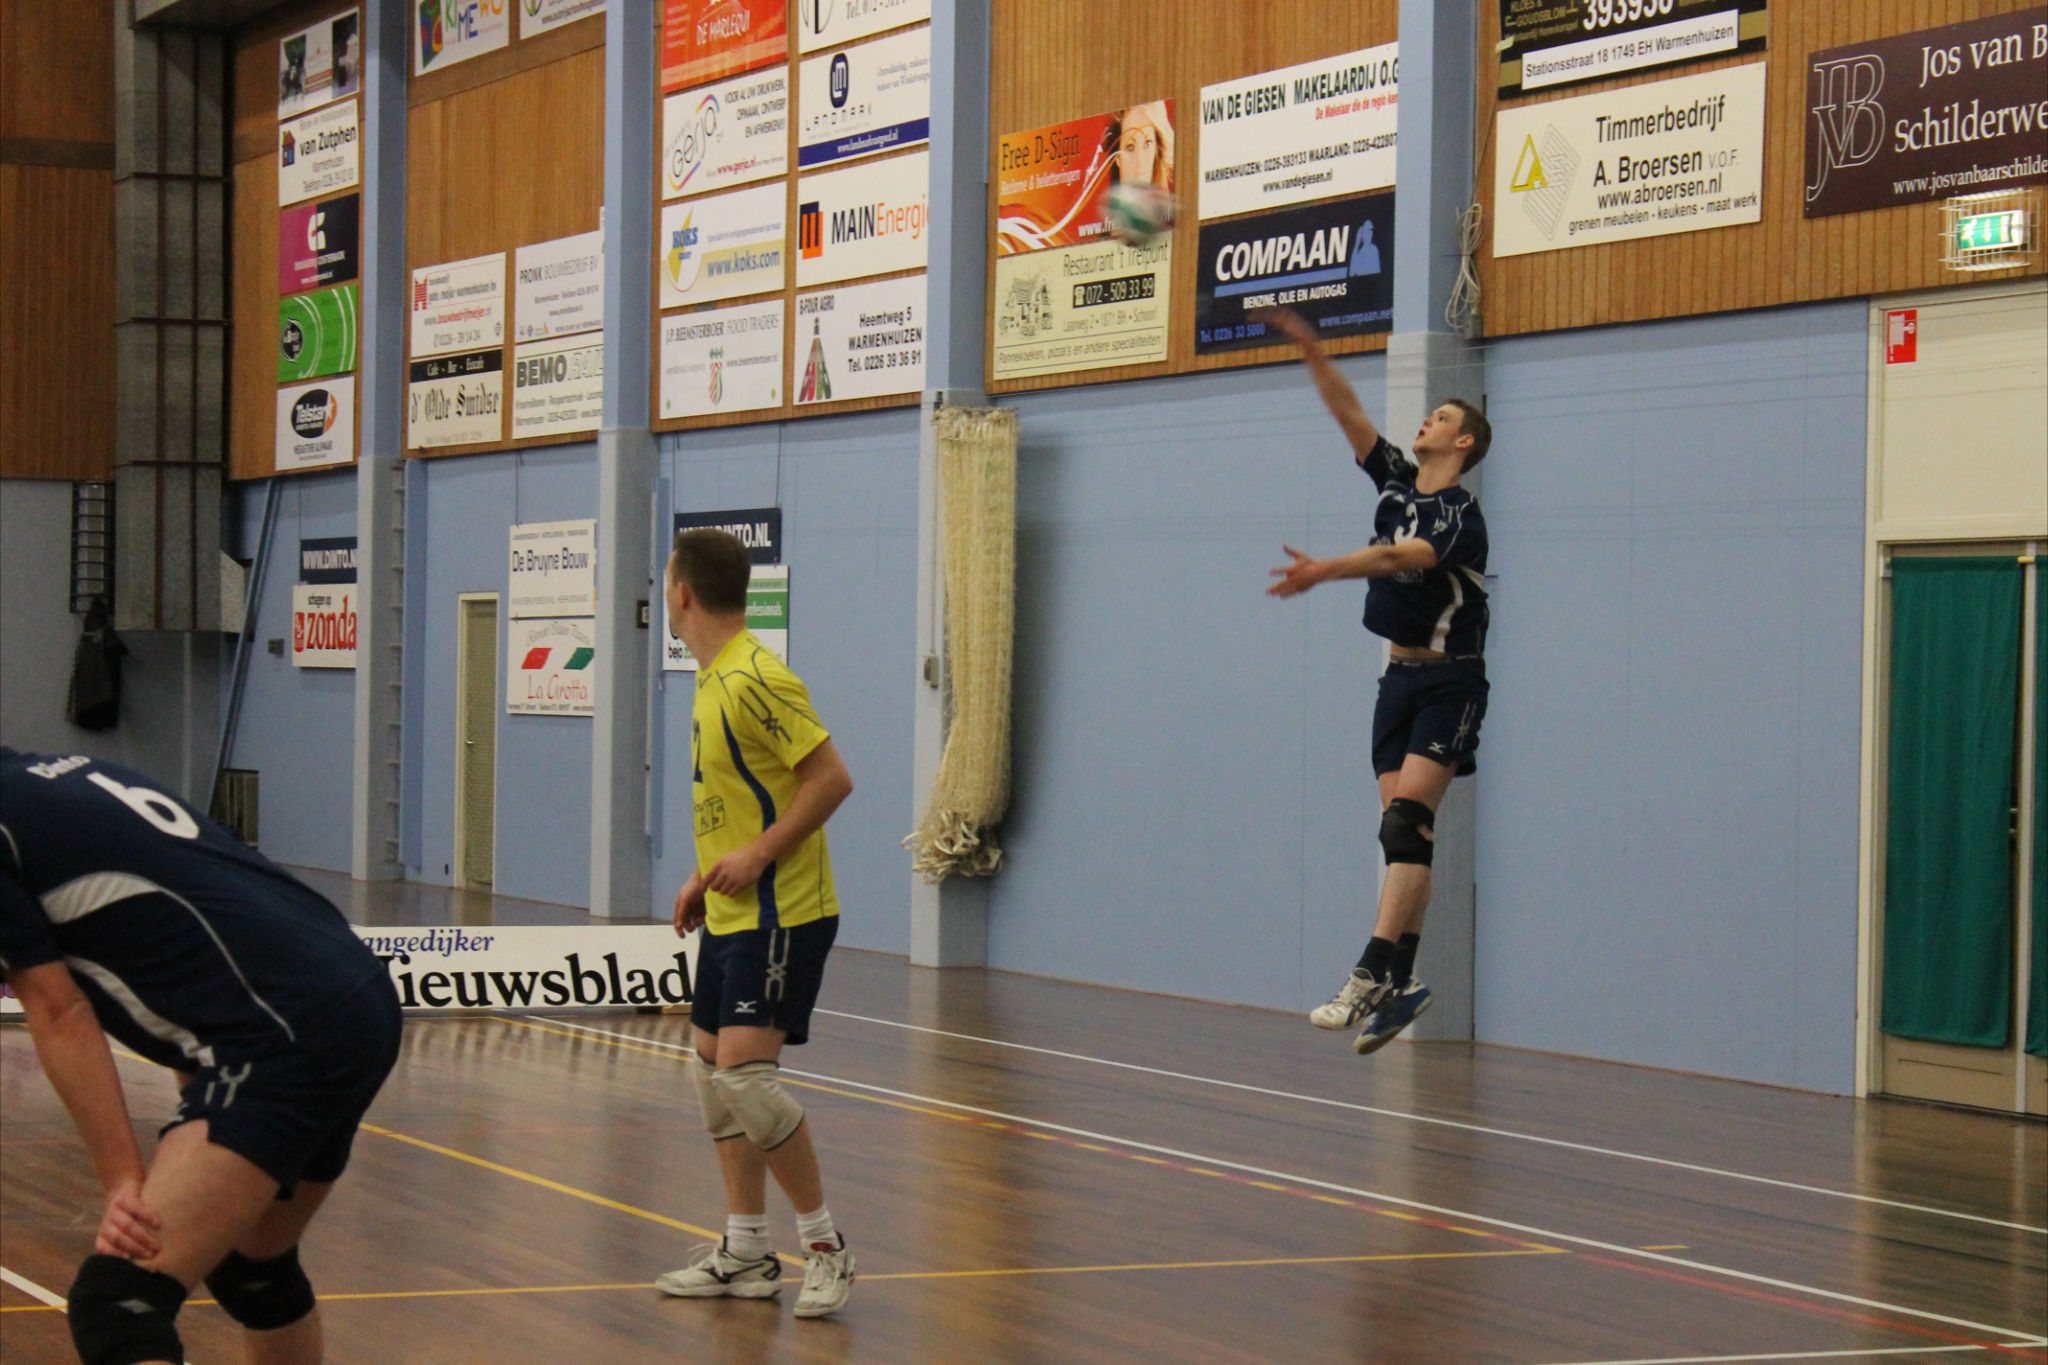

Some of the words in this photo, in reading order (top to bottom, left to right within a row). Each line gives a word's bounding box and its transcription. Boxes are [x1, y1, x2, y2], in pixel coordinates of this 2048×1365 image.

[1525, 55, 1595, 78] Stationsstraat
[1597, 49, 1609, 64] 18
[1611, 43, 1636, 60] 1749
[1637, 41, 1653, 56] EH
[1656, 24, 1735, 52] Warmenhuizen
[1918, 45, 1962, 89] Jos
[1968, 32, 2024, 70] van
[1203, 97, 1225, 125] VAN
[1227, 92, 1242, 120] DE
[1244, 83, 1287, 117] GIESEN
[1293, 62, 1378, 105] MAKELAARDIJ
[1595, 94, 1727, 144] Timmerbedrijf
[318, 125, 357, 152] Zutphen
[1002, 142, 1030, 171] Free
[1034, 130, 1081, 167] D-Sign
[1593, 160, 1612, 188] A.
[1618, 150, 1703, 184] Broersen
[1707, 148, 1740, 170] V.O.F.
[1597, 172, 1723, 209] www.abroersen.nl
[1568, 217, 1601, 236] grenen
[1602, 208, 1649, 229] meubelen
[1657, 199, 1698, 221] keukens
[1706, 196, 1731, 214] maat
[1733, 190, 1759, 209] werk
[672, 227, 698, 249] KOKS
[1214, 224, 1350, 282] COMPAAN
[706, 249, 780, 278] www.koks.com
[1063, 252, 1115, 277] Restaurant
[1242, 293, 1278, 310] BENZINE,
[1278, 290, 1296, 305] OLIE
[1297, 288, 1308, 301] EN
[1309, 282, 1348, 300] AUTOGAS
[859, 308, 905, 328] Heemtweg
[906, 304, 912, 322] 5
[847, 326, 923, 352] WARMENHUIZEN
[516, 353, 568, 388] BEMO
[847, 356, 862, 374] Tel.
[864, 353, 885, 372] 0226
[887, 351, 898, 369] 39
[899, 350, 910, 368] 36
[512, 550, 524, 572] De
[527, 548, 560, 577] Bruyne
[562, 546, 589, 570] Bouw
[306, 594, 357, 650] zonda
[86, 771, 200, 840] 6
[362, 929, 495, 957] angedijker
[376, 951, 697, 1009] ieuwsblad
